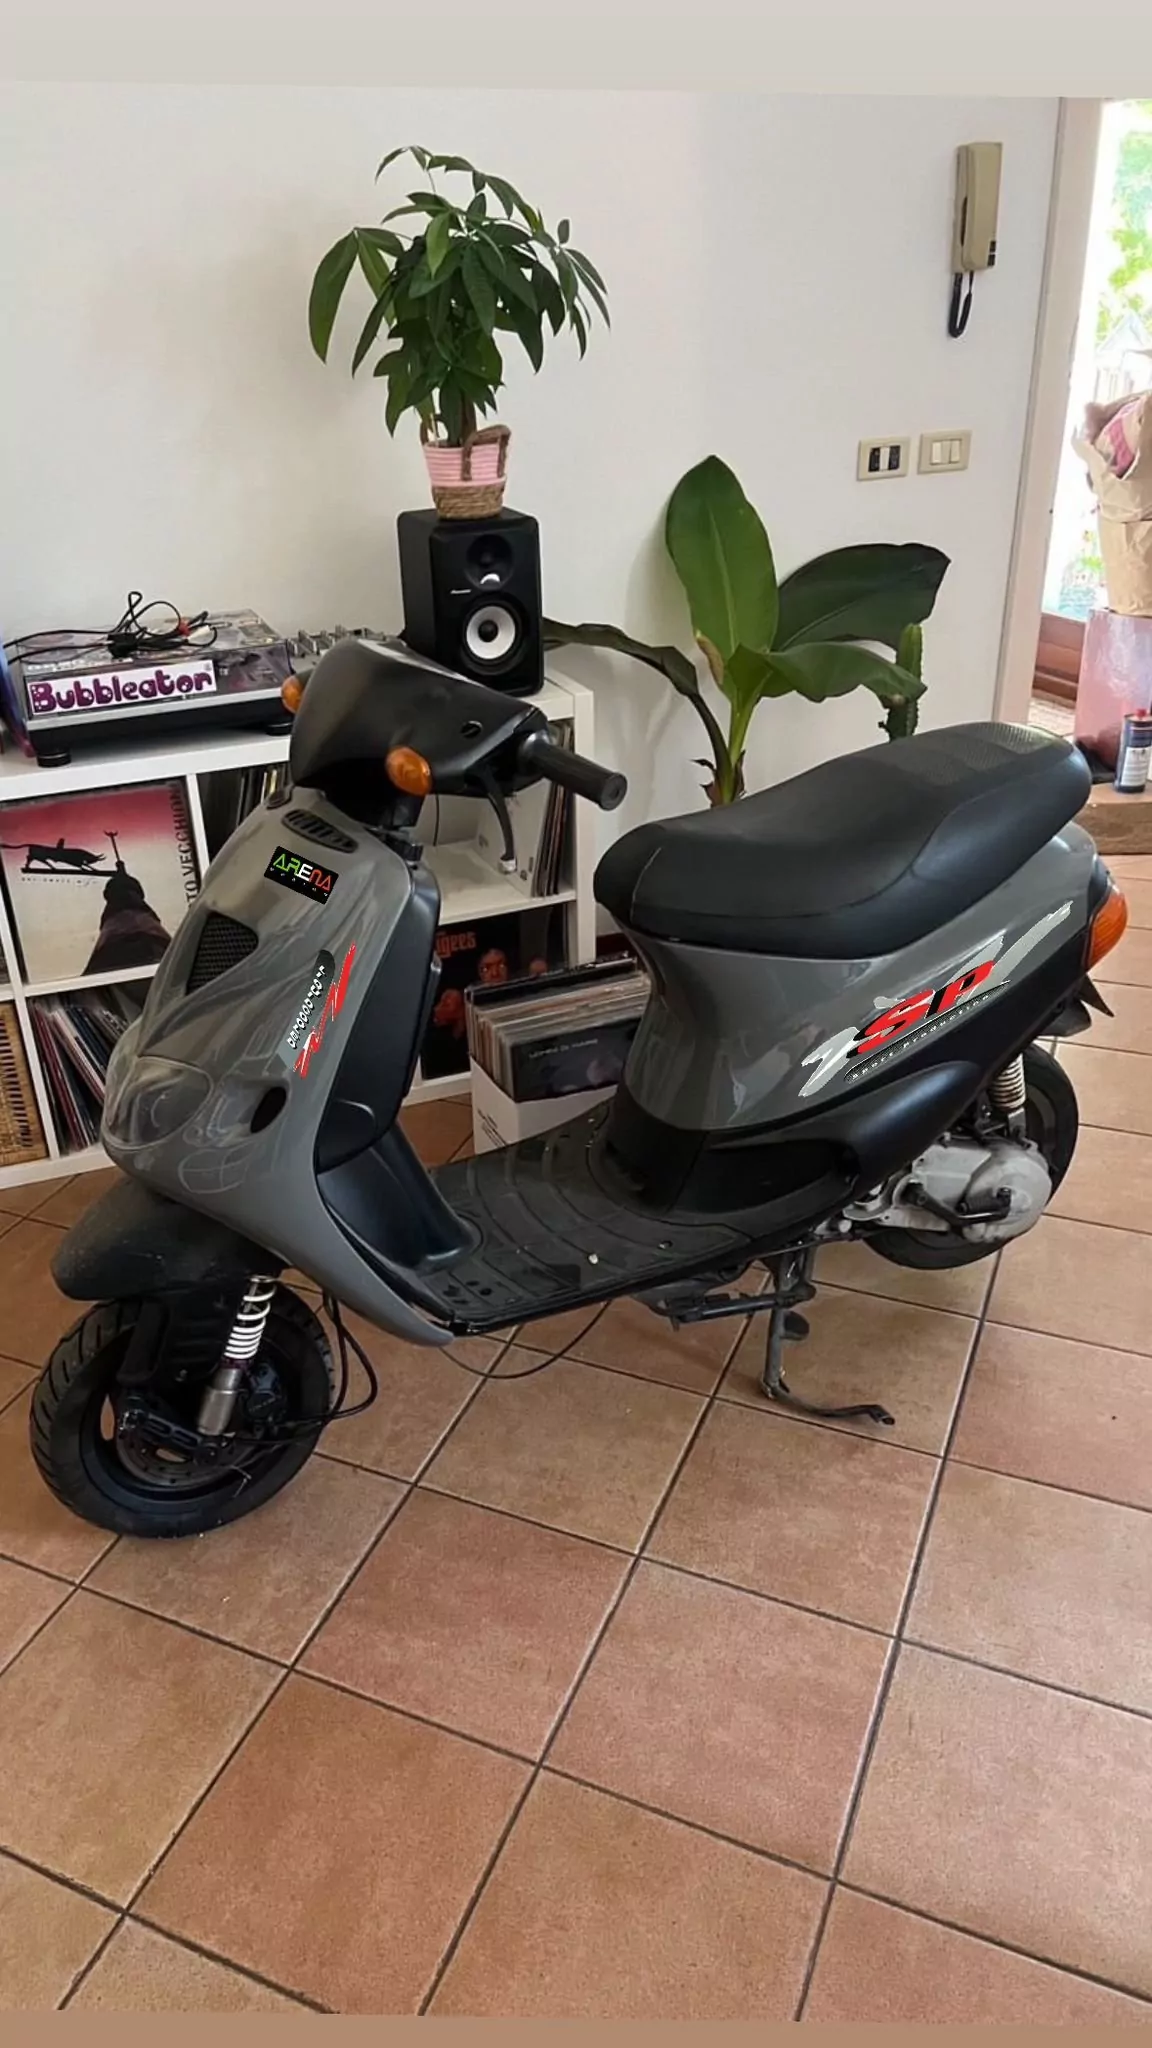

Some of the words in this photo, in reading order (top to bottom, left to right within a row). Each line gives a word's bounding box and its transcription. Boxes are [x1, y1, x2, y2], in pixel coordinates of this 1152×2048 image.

[30, 669, 213, 713] Bubbleator
[272, 853, 331, 892] ARENA
[184, 880, 199, 909] TO
